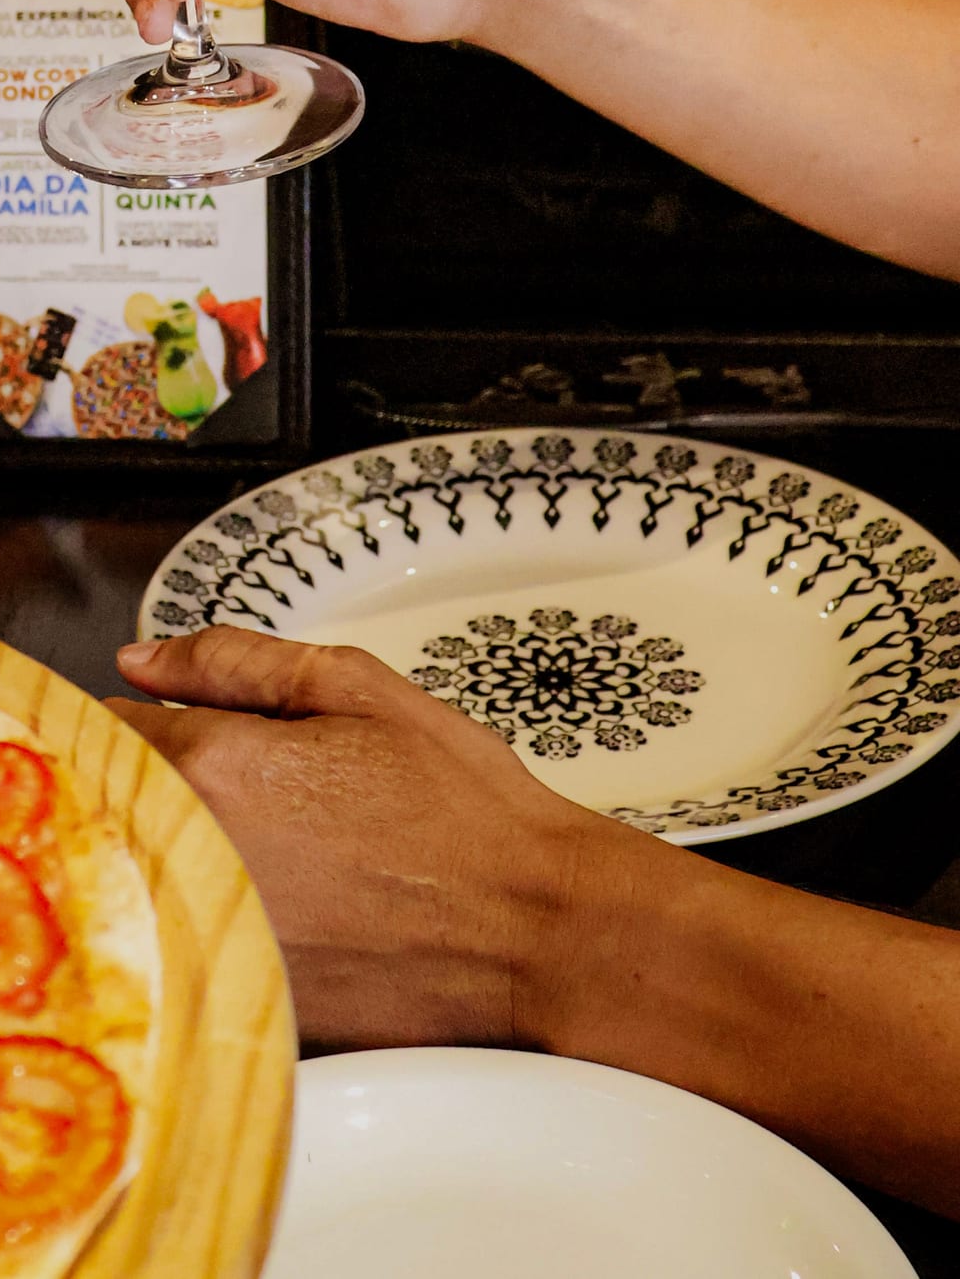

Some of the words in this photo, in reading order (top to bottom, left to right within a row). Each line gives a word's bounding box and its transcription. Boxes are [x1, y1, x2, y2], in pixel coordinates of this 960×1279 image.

[16, 7, 125, 21] EXPERIÊNCIA
[33, 69, 89, 83] COST
[46, 175, 88, 194] DA
[116, 193, 216, 210] QUINTA
